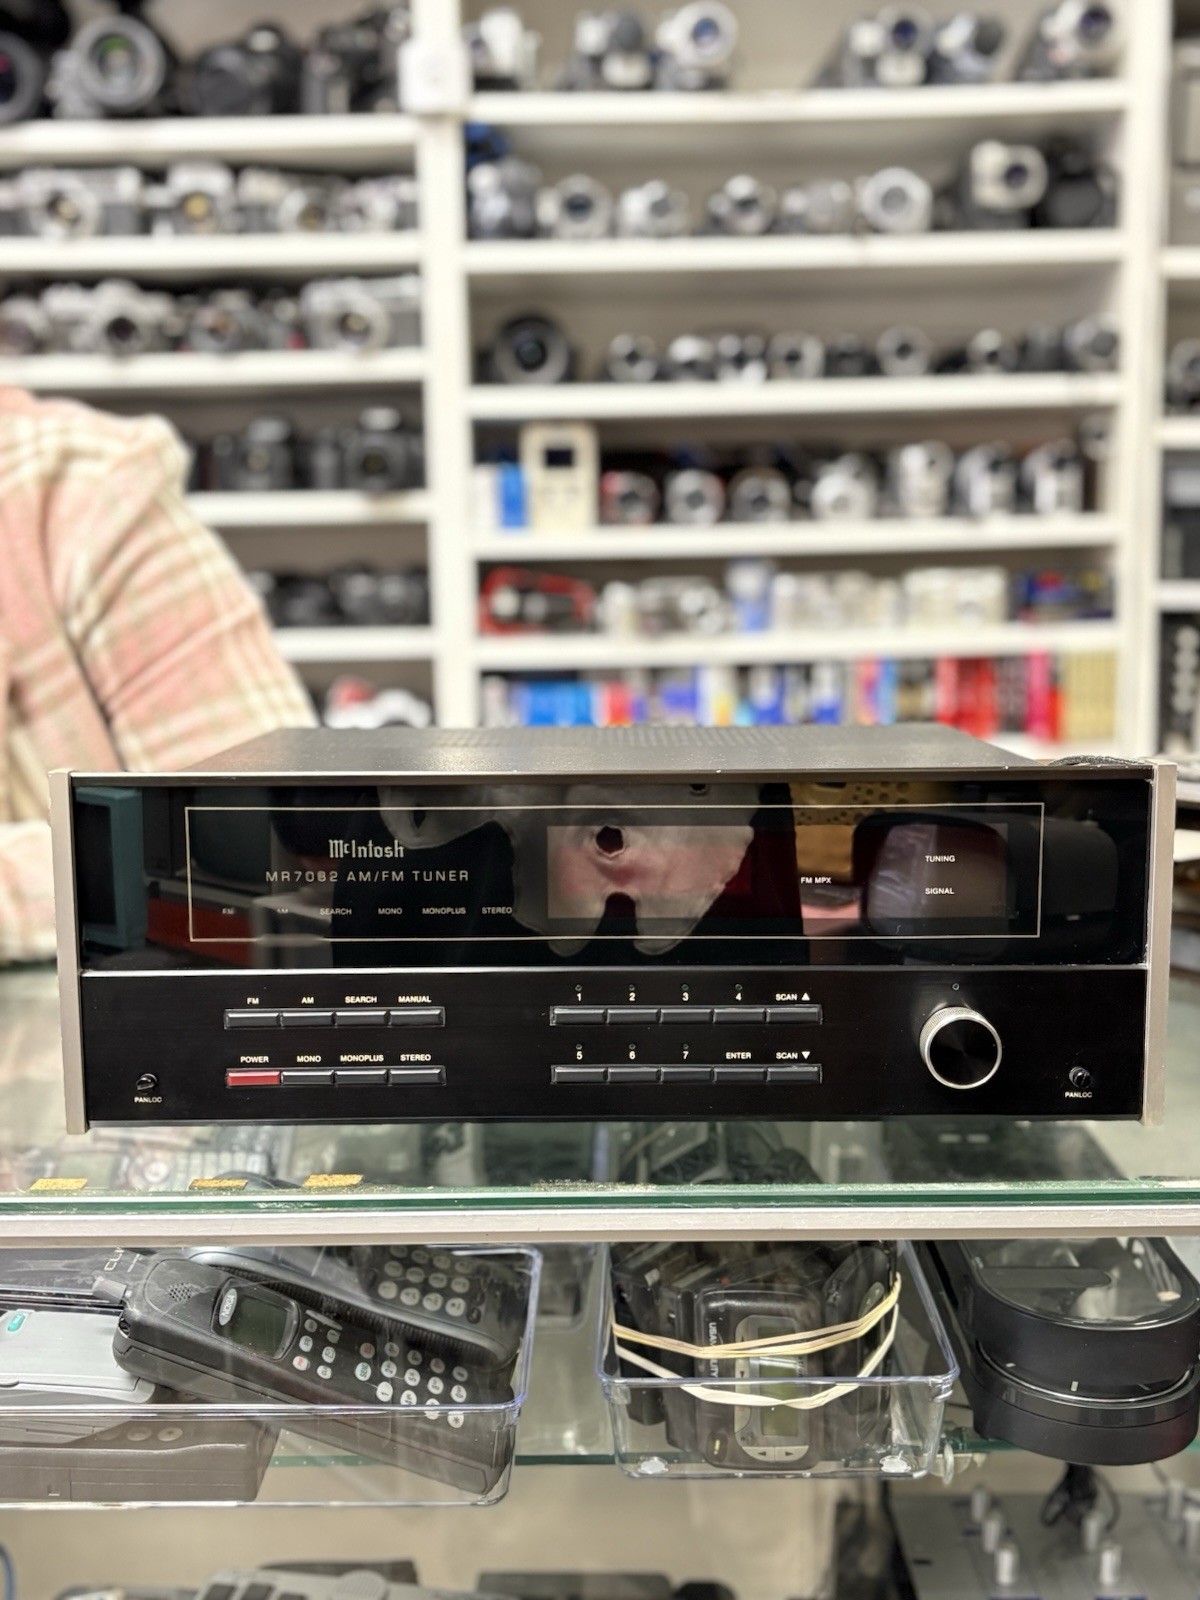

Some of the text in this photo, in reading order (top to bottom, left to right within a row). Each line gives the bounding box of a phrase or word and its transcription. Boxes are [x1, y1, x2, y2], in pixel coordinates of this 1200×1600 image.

[328, 838, 406, 860] McIntosh
[924, 854, 956, 863] TUNING
[346, 870, 404, 882] AM/FM
[411, 869, 469, 882] TUNER
[800, 876, 832, 884] FM MPX
[924, 887, 955, 895] SIGNAL
[319, 907, 353, 916] SEARCH
[377, 907, 403, 915] MONO
[421, 906, 467, 915] MONOPLUS
[481, 906, 513, 915] STEREO
[246, 997, 260, 1005] FM
[301, 996, 315, 1004] AM
[344, 995, 378, 1004] SEARCH
[397, 995, 432, 1003] MANUAL
[576, 992, 582, 1002] 1
[629, 992, 636, 1002] 2
[682, 991, 689, 1002] 3
[735, 992, 742, 1001] 4
[775, 993, 798, 1002] SCAN
[240, 1055, 270, 1064] POWER
[296, 1054, 322, 1063] MONO
[339, 1054, 385, 1063] MONOPLUS
[400, 1053, 432, 1062] STEREO
[576, 1050, 583, 1060] 5
[628, 1050, 636, 1060] 6
[682, 1050, 689, 1060] 7
[725, 1051, 752, 1060] ENTER
[775, 1051, 799, 1060] SCAN
[133, 1096, 163, 1104] PANLOC
